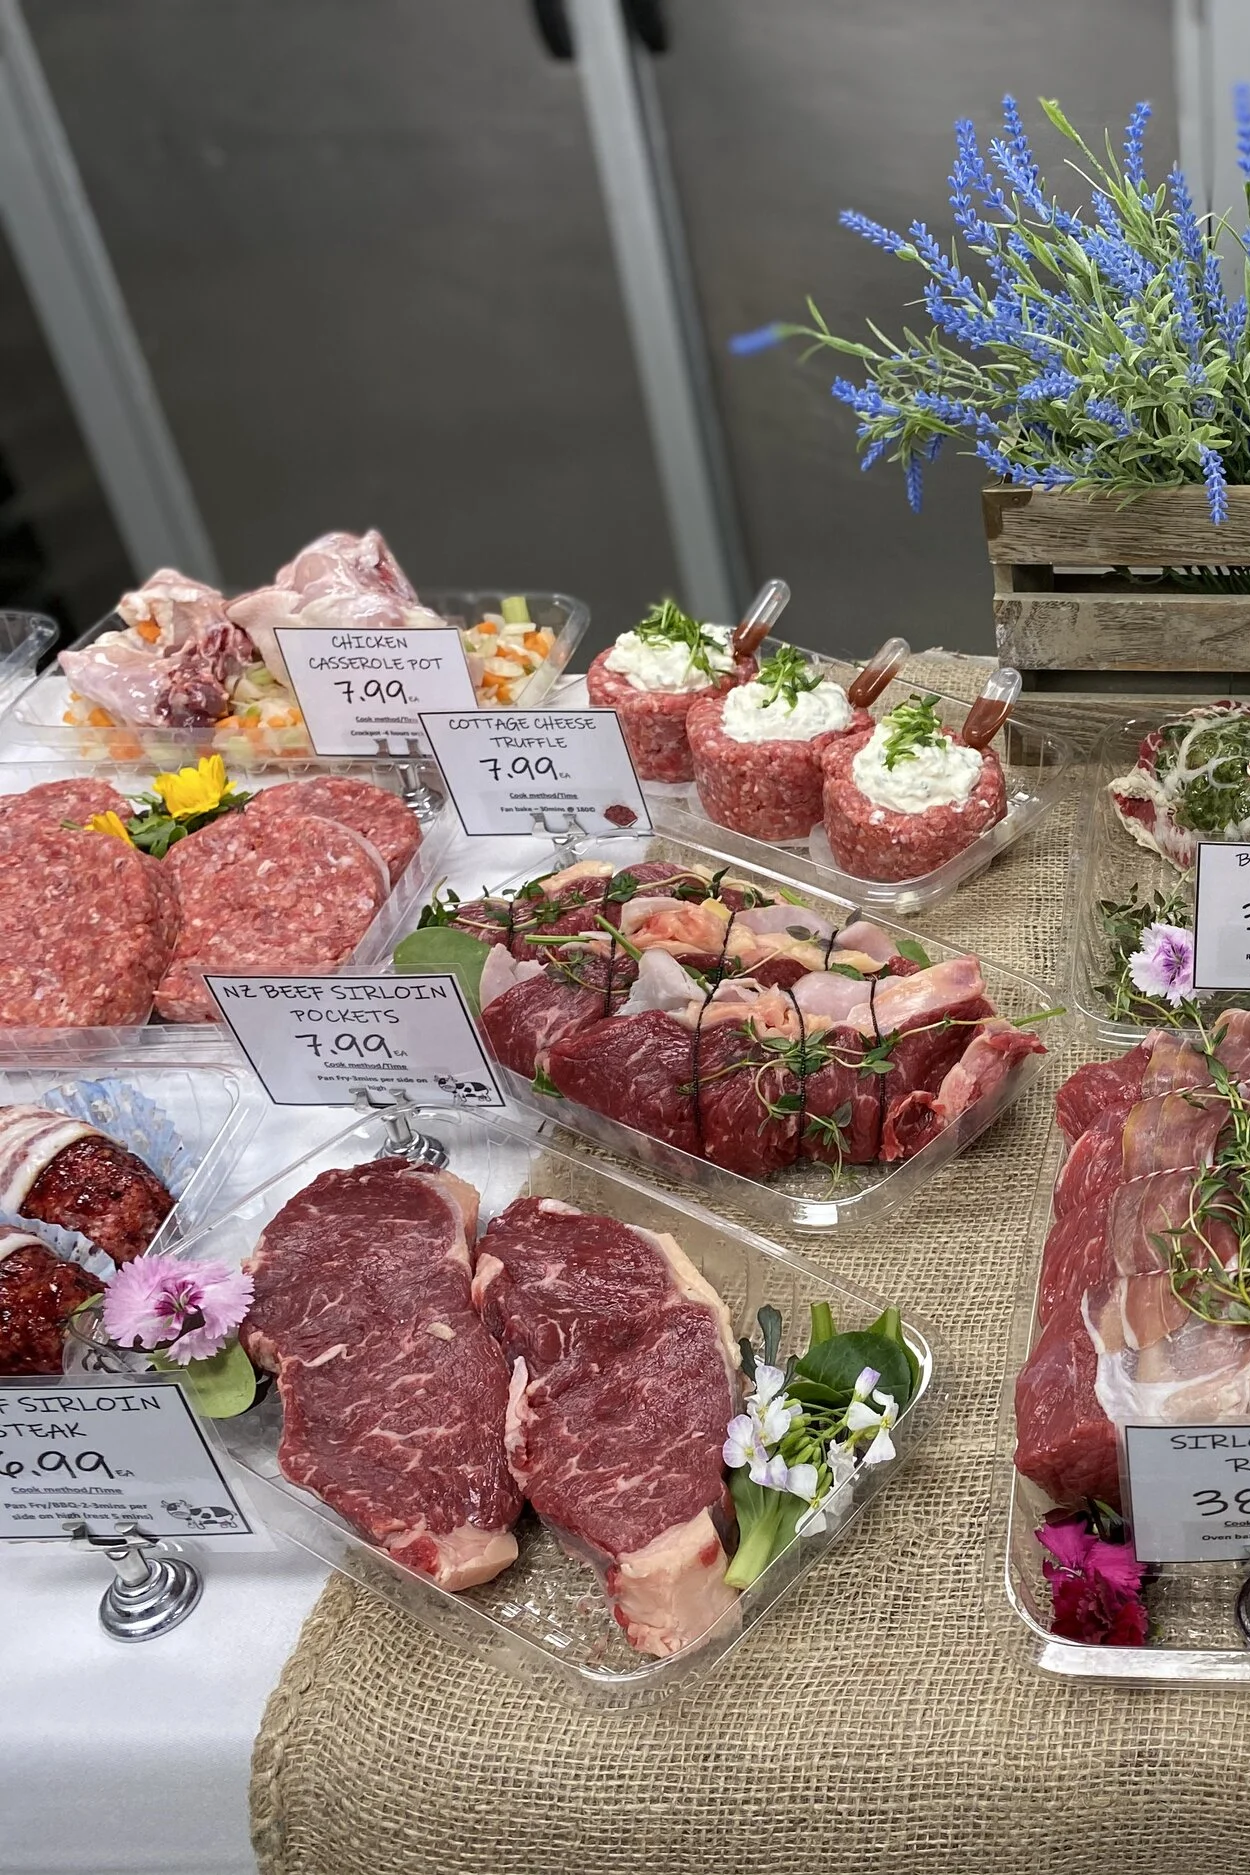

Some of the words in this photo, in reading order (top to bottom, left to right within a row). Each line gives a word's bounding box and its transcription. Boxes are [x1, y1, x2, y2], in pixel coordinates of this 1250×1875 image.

[331, 634, 408, 650] CHICKEN
[308, 657, 409, 671] CASSEROLE
[411, 657, 443, 671] POT
[334, 679, 408, 704] 7.99
[449, 718, 530, 730] COTTAGE
[534, 718, 597, 730] CHEESE
[490, 736, 568, 749] TRUFFLE
[478, 756, 559, 781] 7.99
[223, 985, 258, 999] NZ
[260, 985, 324, 1000] BEEF
[330, 985, 448, 1000] SIRLOIN
[290, 1009, 400, 1024] POCKETS
[295, 1033, 393, 1058] 7.99
[348, 1062, 408, 1070] method/Time
[18, 1396, 161, 1412] SIRLOIN
[11, 1486, 40, 1494] Cook
[44, 1487, 124, 1495] method/Time
